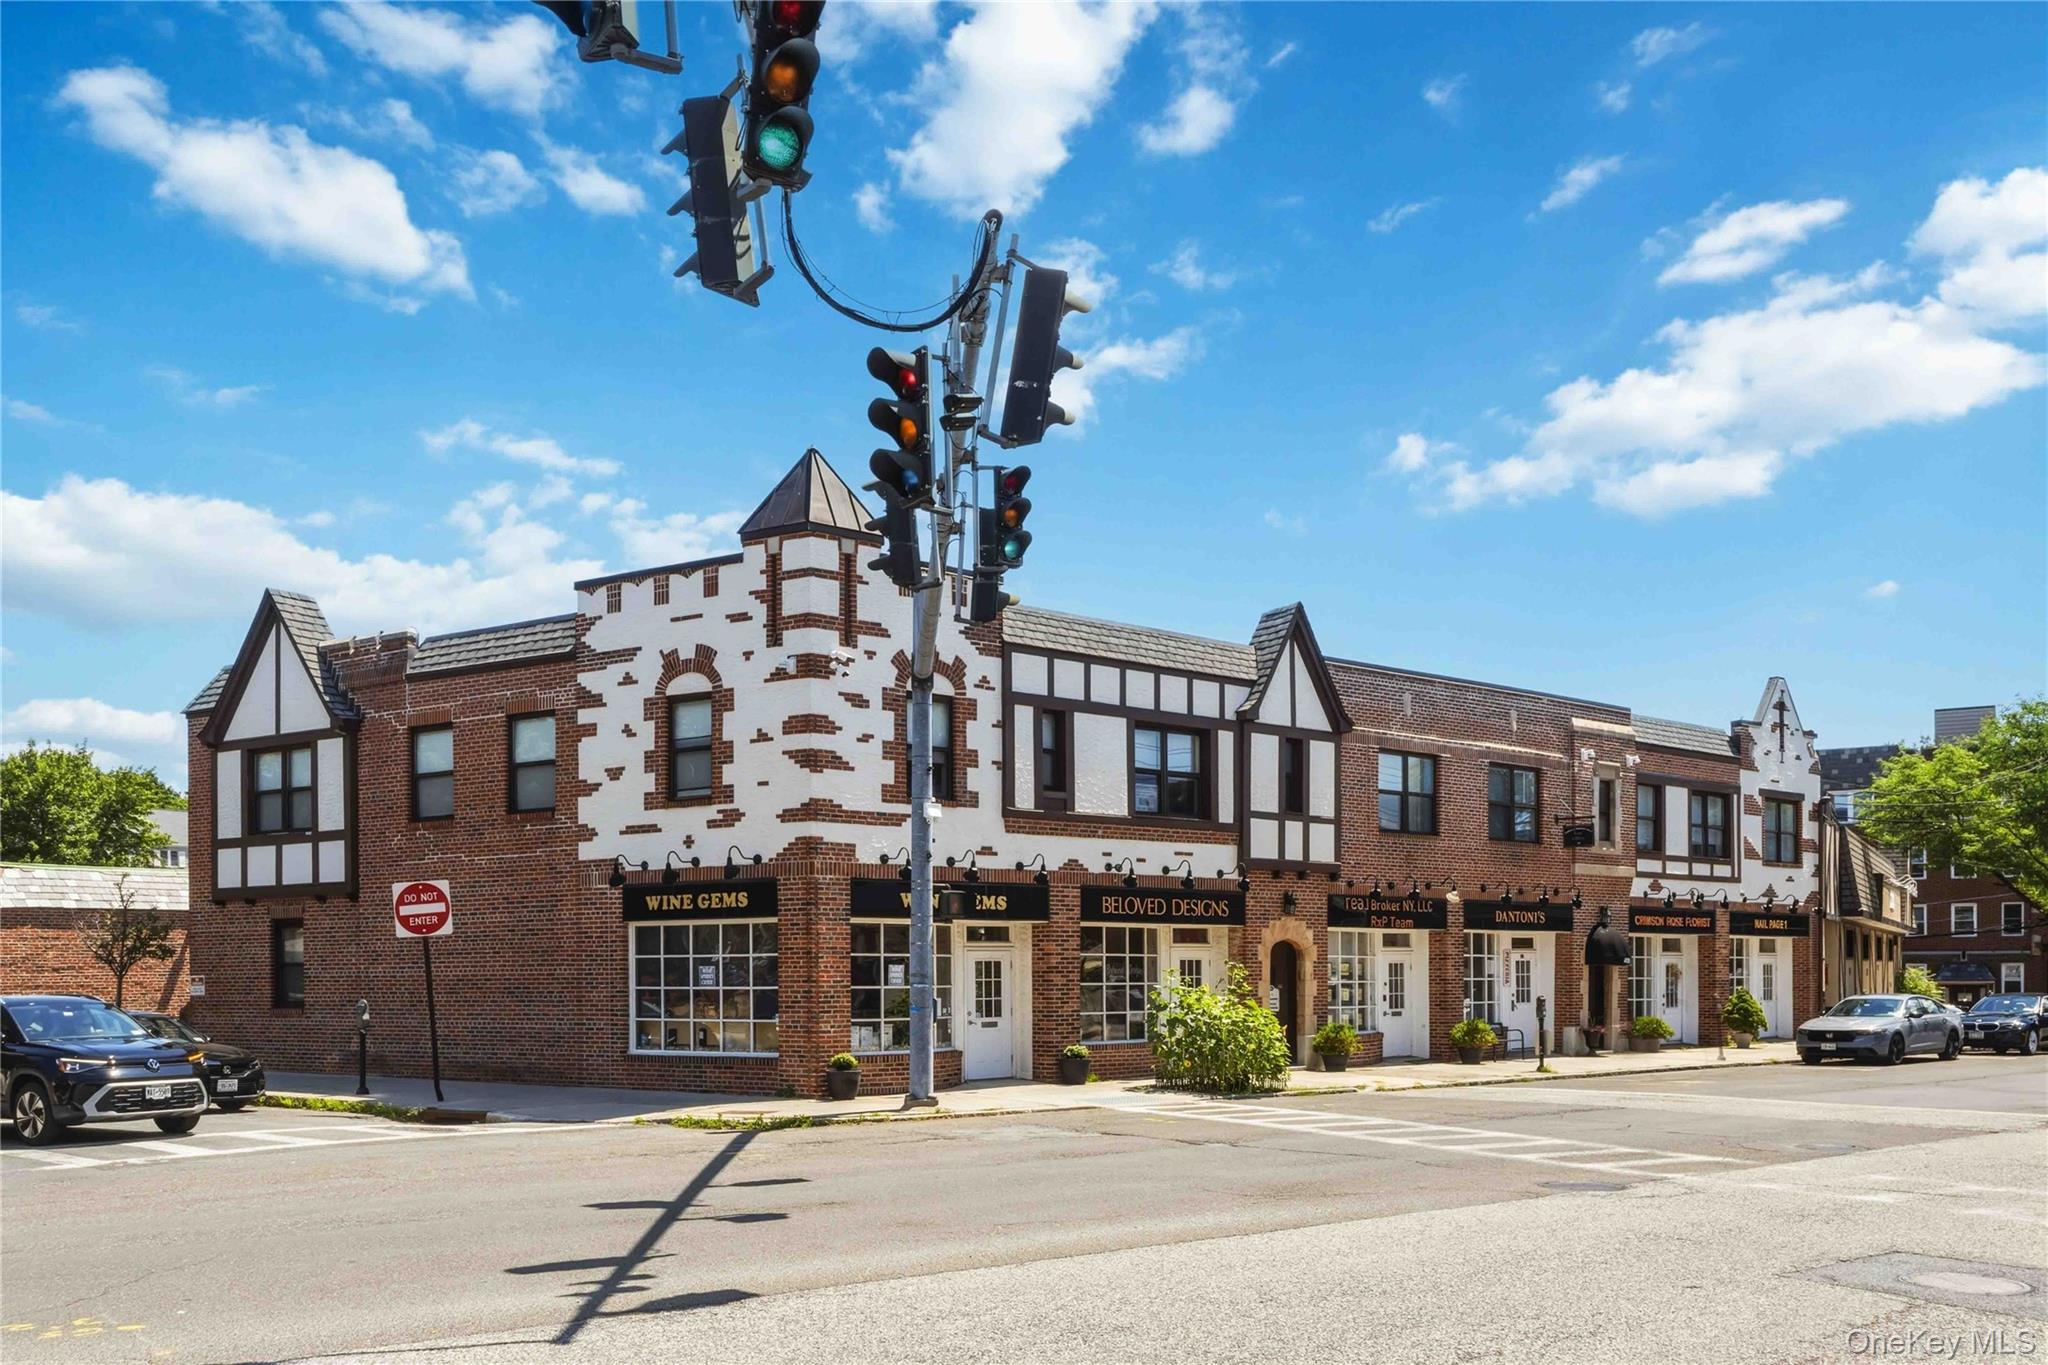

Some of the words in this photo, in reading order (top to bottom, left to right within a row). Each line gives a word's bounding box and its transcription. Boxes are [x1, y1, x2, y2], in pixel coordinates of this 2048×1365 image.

[404, 894, 417, 903] DO
[420, 892, 438, 902] NOT
[645, 894, 694, 911] WINE
[697, 892, 749, 909] GEMS
[975, 894, 1008, 911] EMS
[1102, 896, 1167, 916] BELOVED
[1172, 898, 1230, 917] DESIGNS
[1370, 900, 1401, 912] Broker
[1417, 901, 1433, 913] LLC
[409, 915, 439, 926] ENTER
[1370, 915, 1388, 928] RxP
[1389, 916, 1414, 928] Team
[1495, 910, 1546, 924] DANTONI'S
[1634, 915, 1665, 926] CRIMSON
[1666, 916, 1684, 927] ROSE
[1685, 917, 1711, 927] FLORIST
[1754, 919, 1768, 929] NAIL
